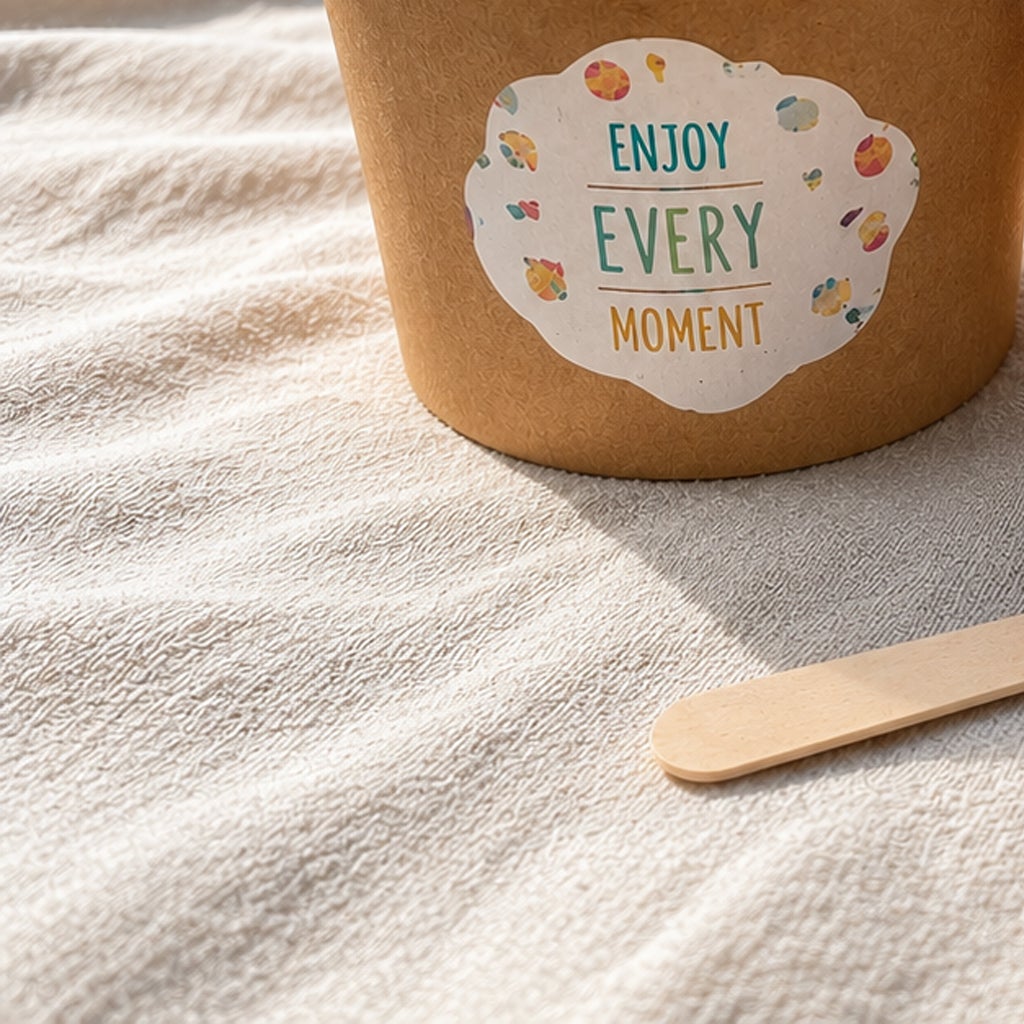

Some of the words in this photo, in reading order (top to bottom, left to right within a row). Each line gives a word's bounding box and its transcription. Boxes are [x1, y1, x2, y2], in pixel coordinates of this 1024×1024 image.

[609, 121, 729, 172] ENJOY
[593, 201, 763, 274] EVERY
[610, 301, 764, 352] MOMENT
